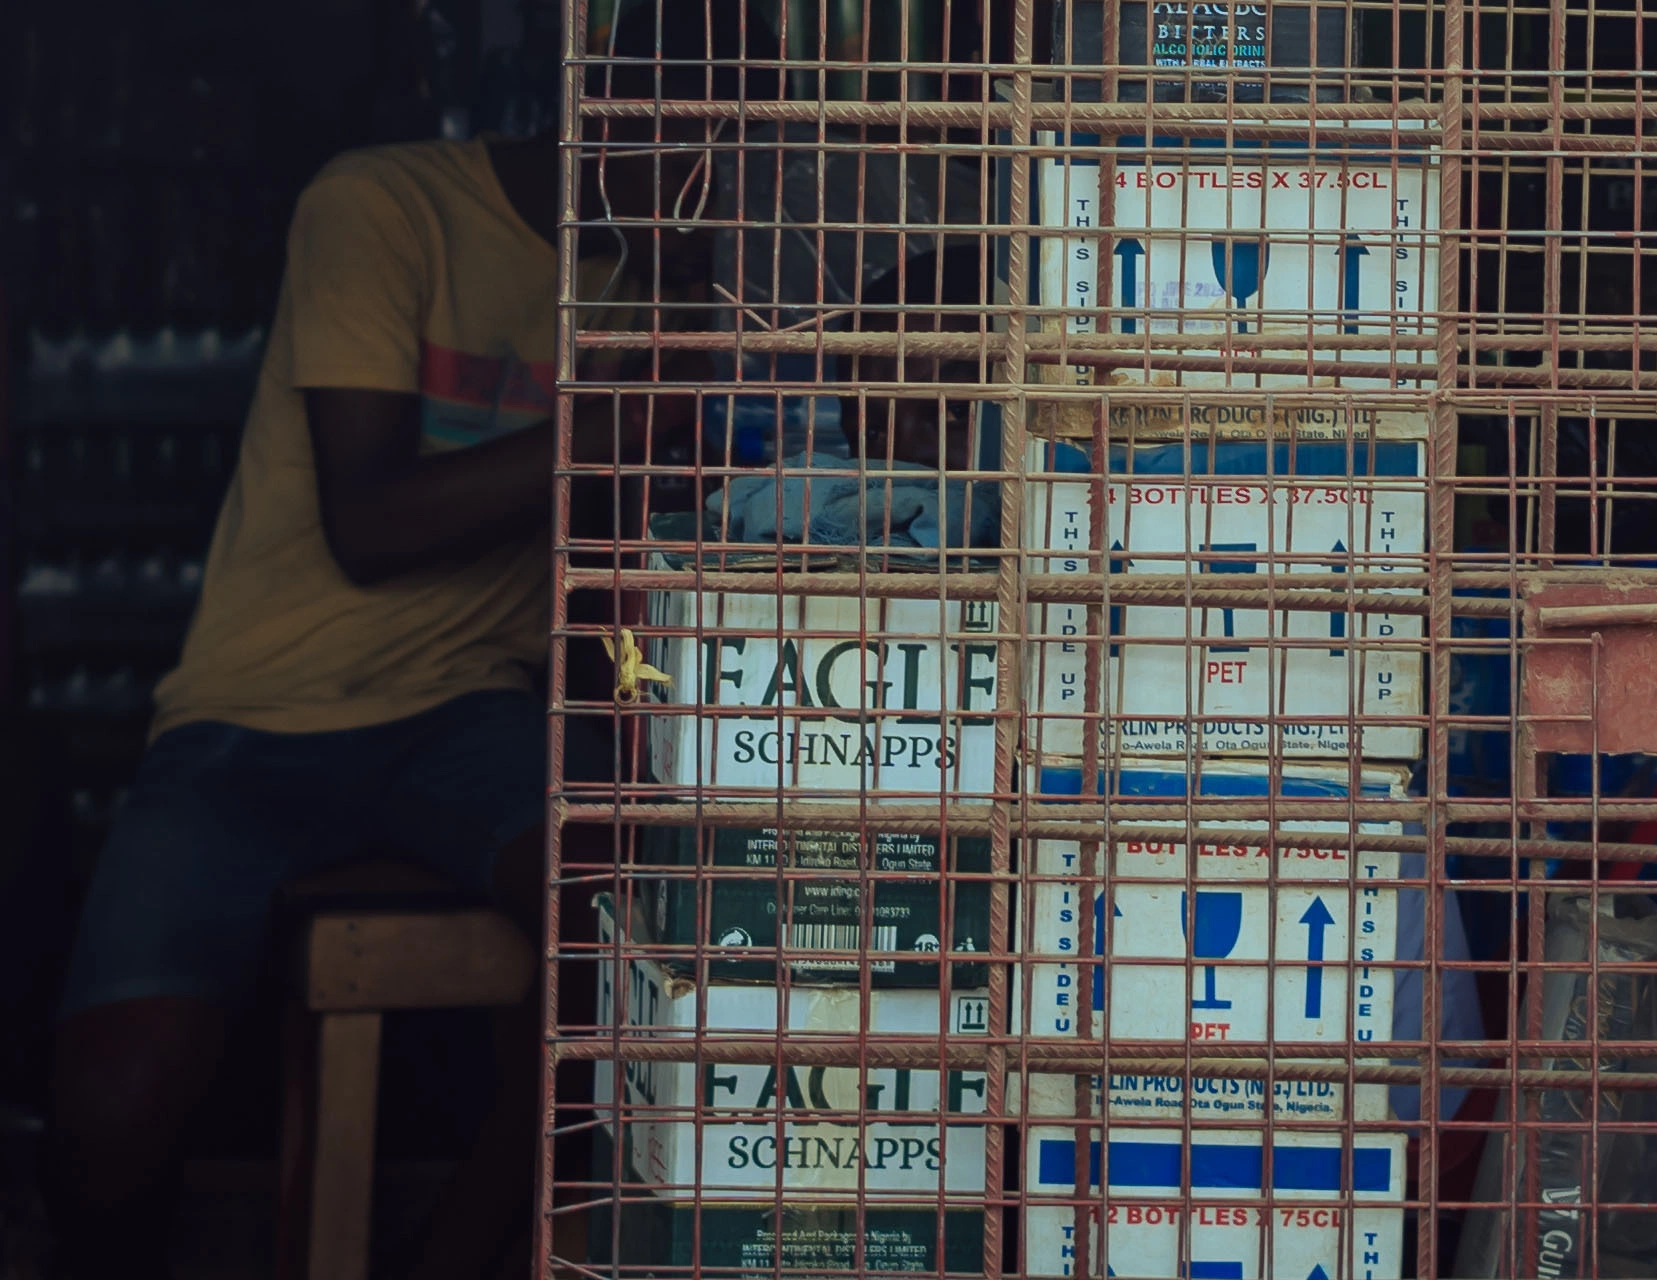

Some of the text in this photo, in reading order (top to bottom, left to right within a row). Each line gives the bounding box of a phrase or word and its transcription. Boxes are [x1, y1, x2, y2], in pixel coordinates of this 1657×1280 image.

[1158, 24, 1266, 42] BITTERS
[1136, 172, 1262, 189] BOTTLES
[1271, 172, 1290, 189] X
[1298, 172, 1388, 189] 37.5CL
[700, 638, 998, 727] EAGLE
[1208, 661, 1247, 684] PET
[1061, 673, 1075, 701] UP
[1378, 673, 1393, 701] UP
[733, 730, 956, 771] SCHNAPPS
[1127, 841, 1248, 858] BOTLES
[1146, 1075, 1241, 1095] PROUCTS
[1245, 1078, 1292, 1100] (NG.)
[1297, 1080, 1335, 1098] LTD.
[1214, 1099, 1245, 1113] Ogun
[1286, 1101, 1335, 1114] Nigeria.
[727, 1135, 947, 1173] SCHNAPPS
[1127, 1206, 1249, 1227] BOTLES
